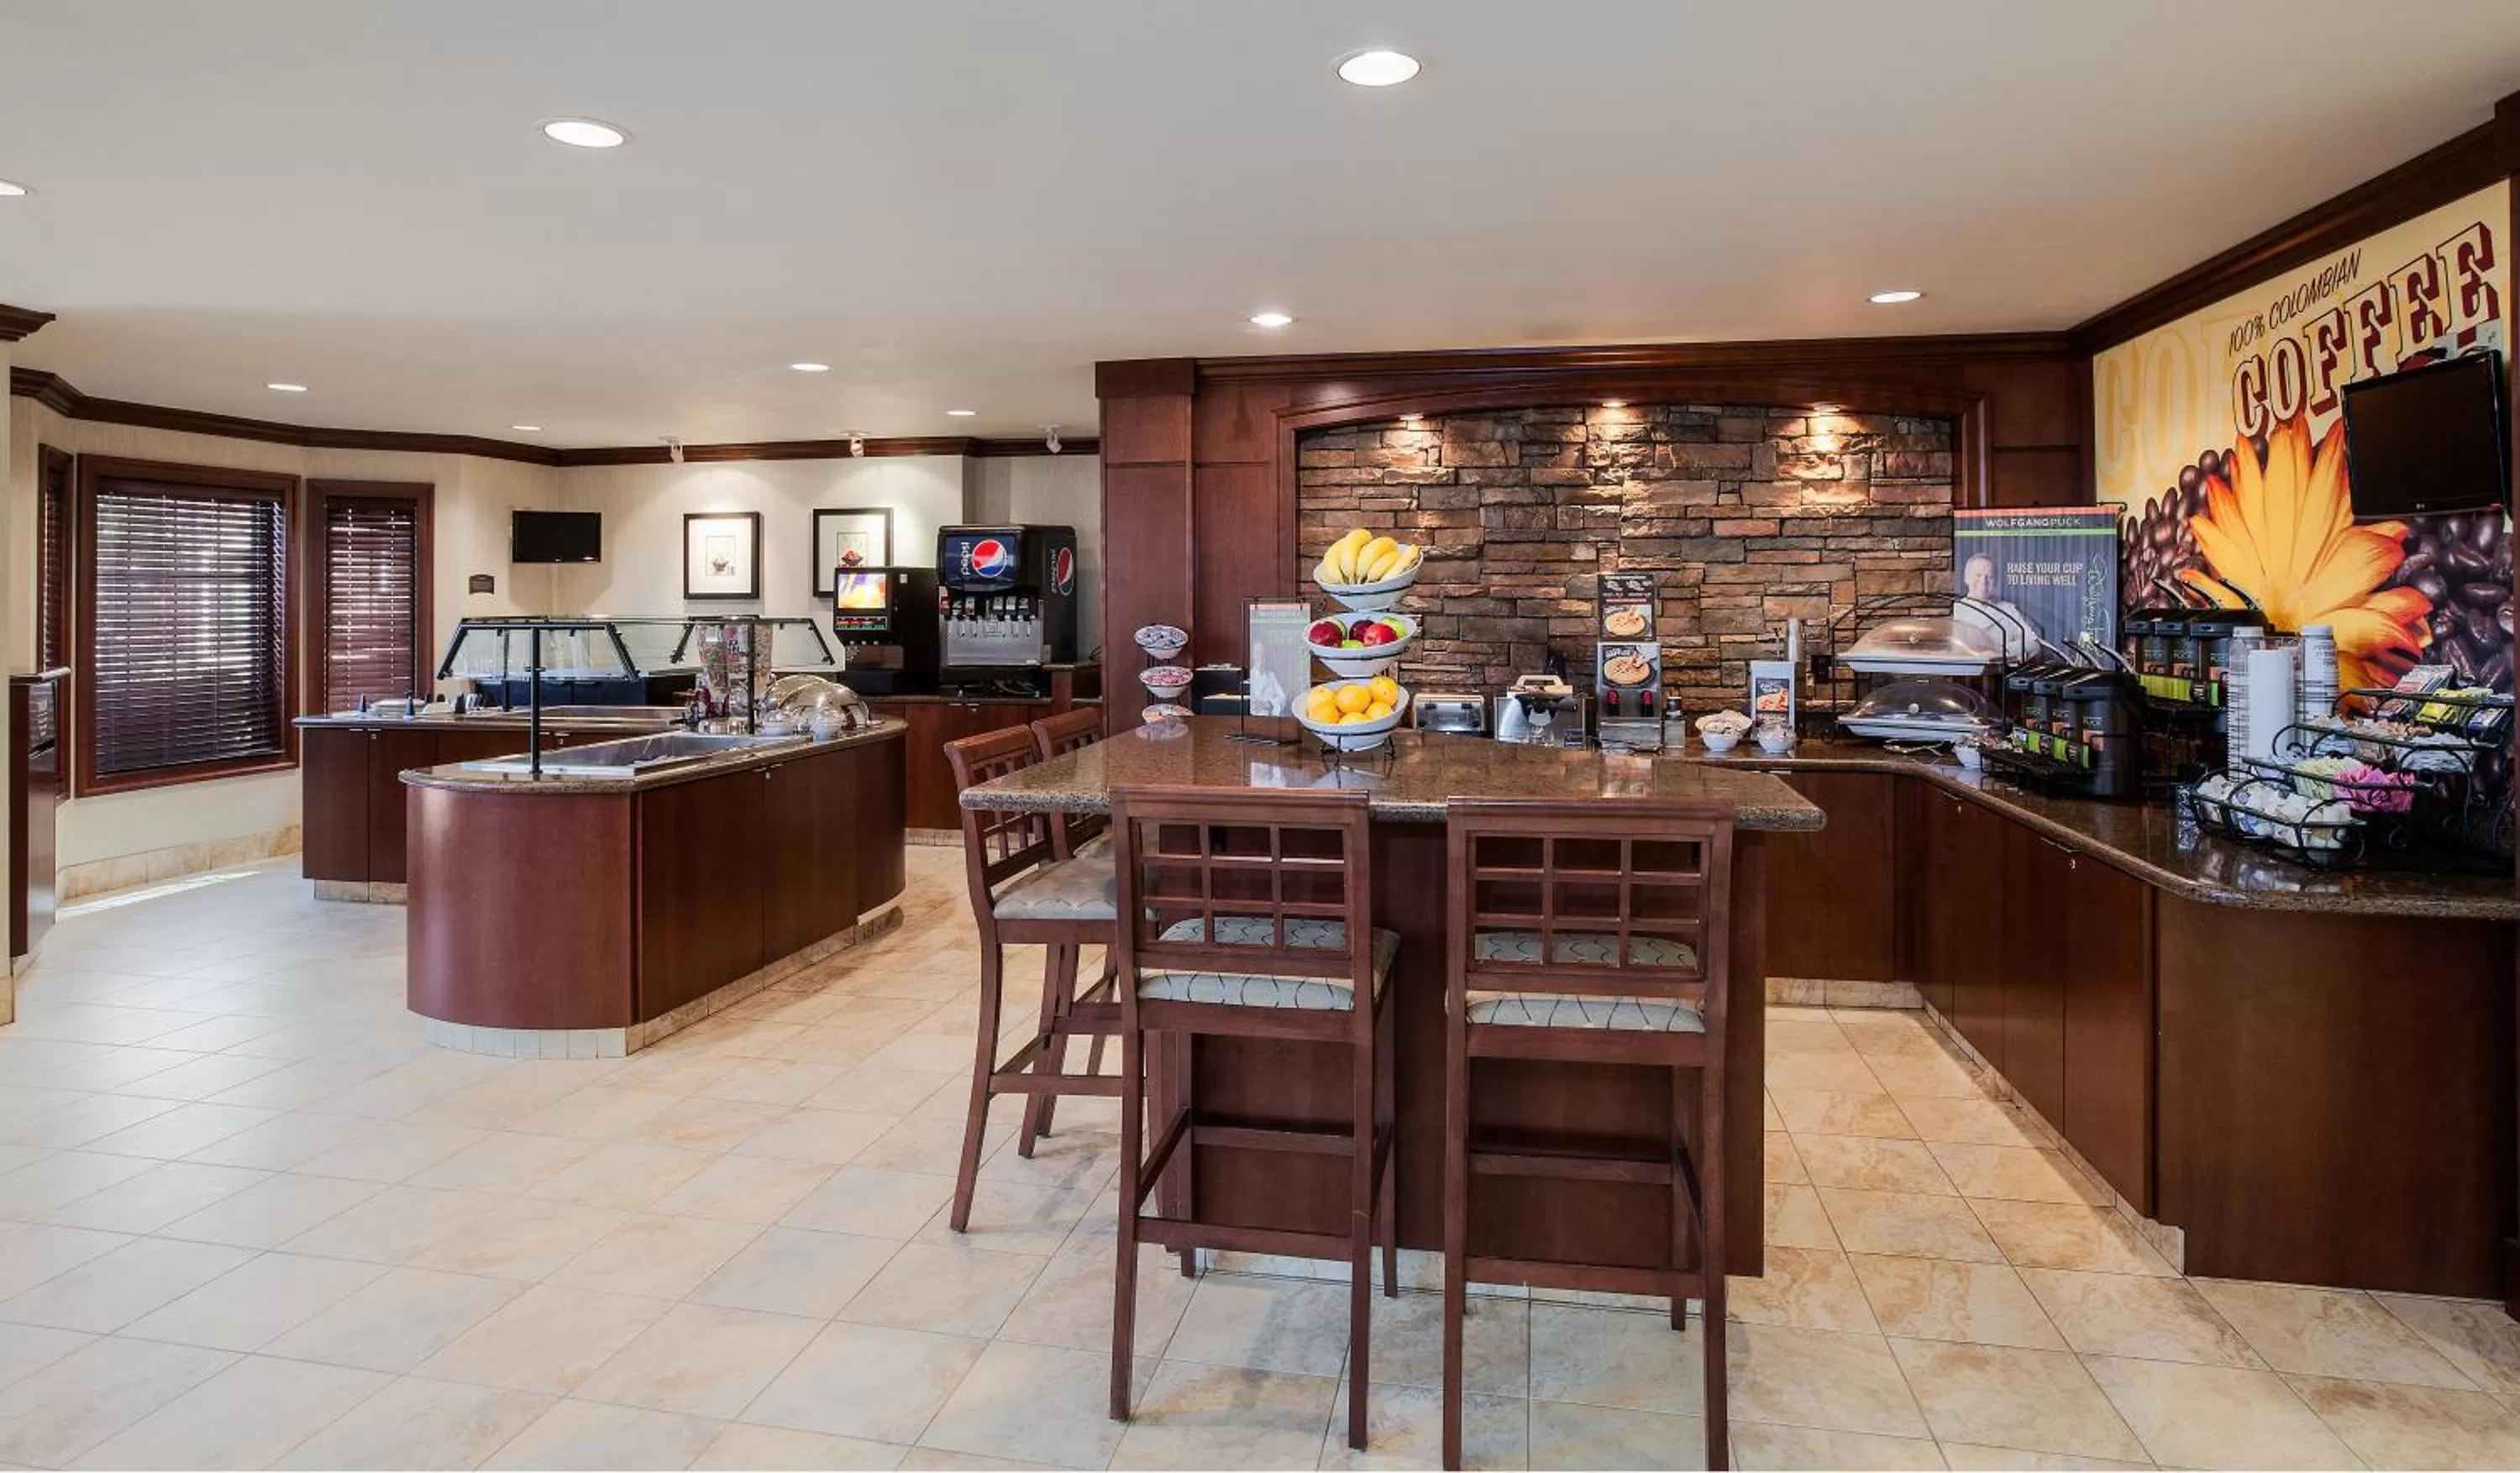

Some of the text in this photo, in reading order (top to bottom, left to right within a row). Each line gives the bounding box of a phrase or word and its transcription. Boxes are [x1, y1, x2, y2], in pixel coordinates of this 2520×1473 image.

[2229, 248, 2362, 356] 100% COLOMBIAN
[2231, 221, 2502, 437] COFFEE
[960, 542, 971, 575] pepsi
[2007, 562, 2083, 574] RAISE YOUR CUP
[2007, 574, 2076, 586] TO LIVING WELL
